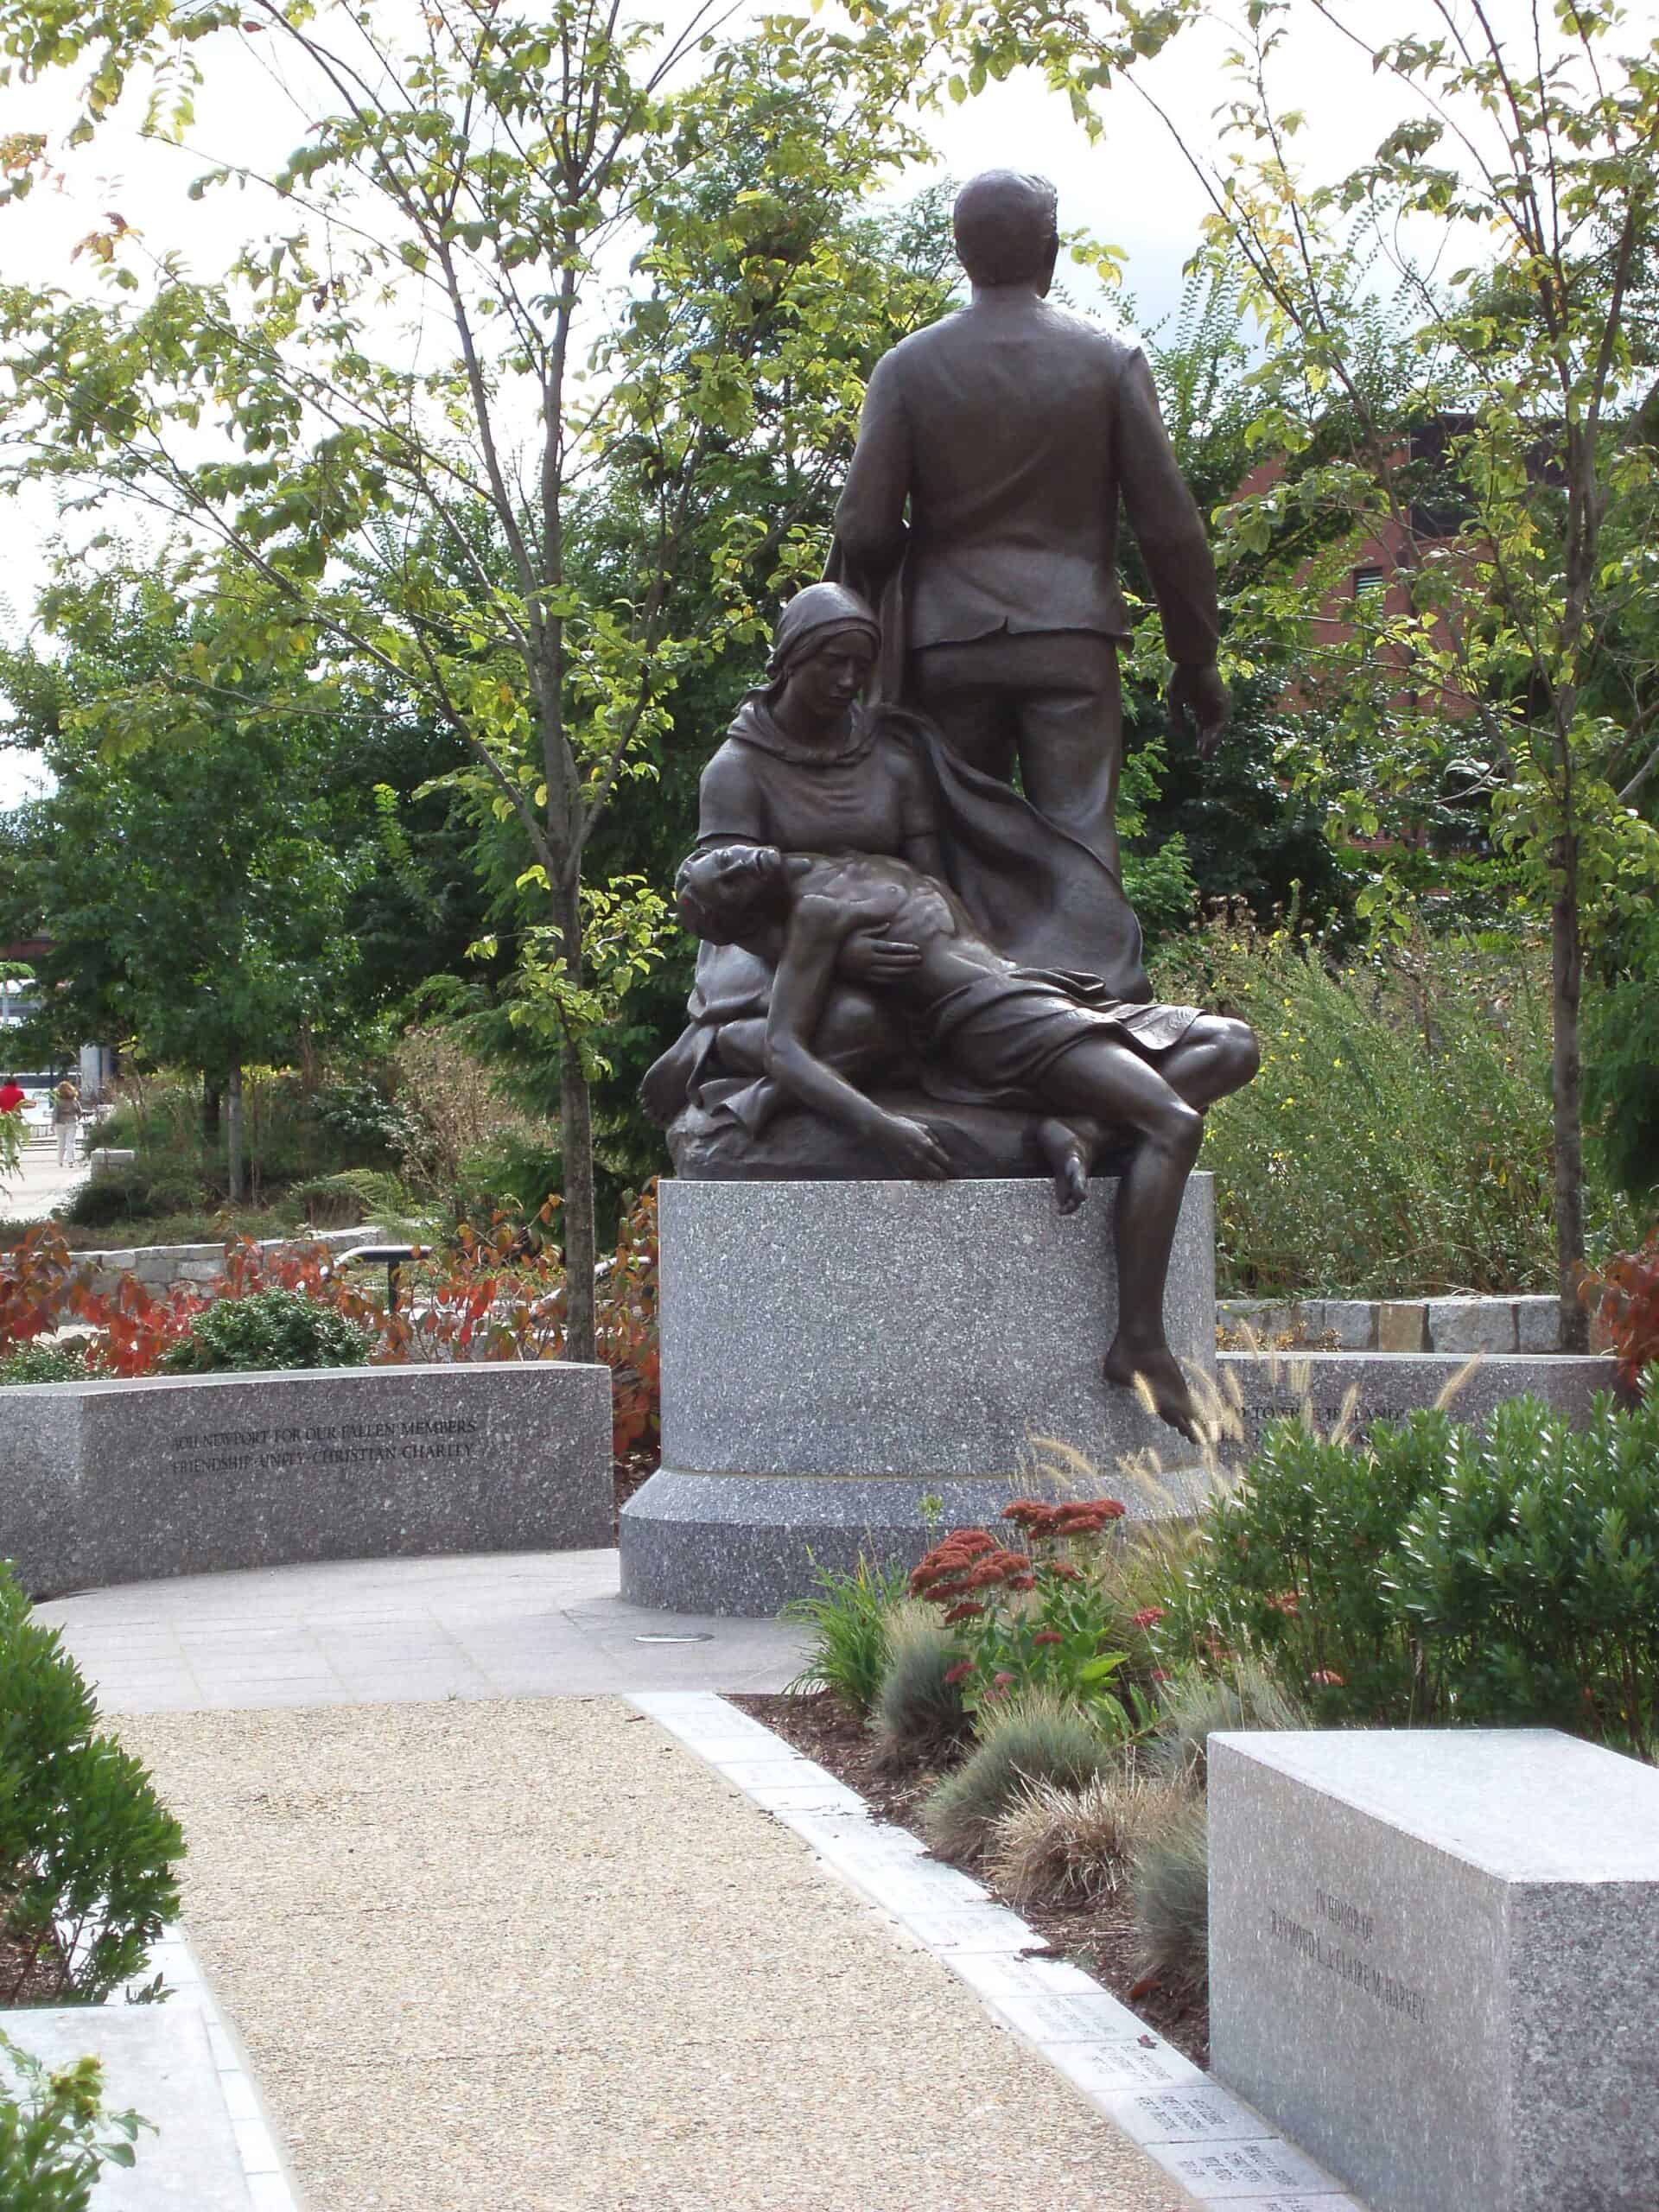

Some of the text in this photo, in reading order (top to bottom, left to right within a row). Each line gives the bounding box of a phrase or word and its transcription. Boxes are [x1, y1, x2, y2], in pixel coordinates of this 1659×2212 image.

[203, 1429, 270, 1448] NEWPORT
[275, 1427, 300, 1444] FOR
[306, 1425, 337, 1442] OUR
[341, 1422, 397, 1440] FALLEN
[400, 1420, 477, 1437] MEMBERS
[173, 1443, 472, 1473] FRIENDSHIP UNITY CHRISTIAN CHARITY
[1328, 1894, 1359, 1931] HONOR
